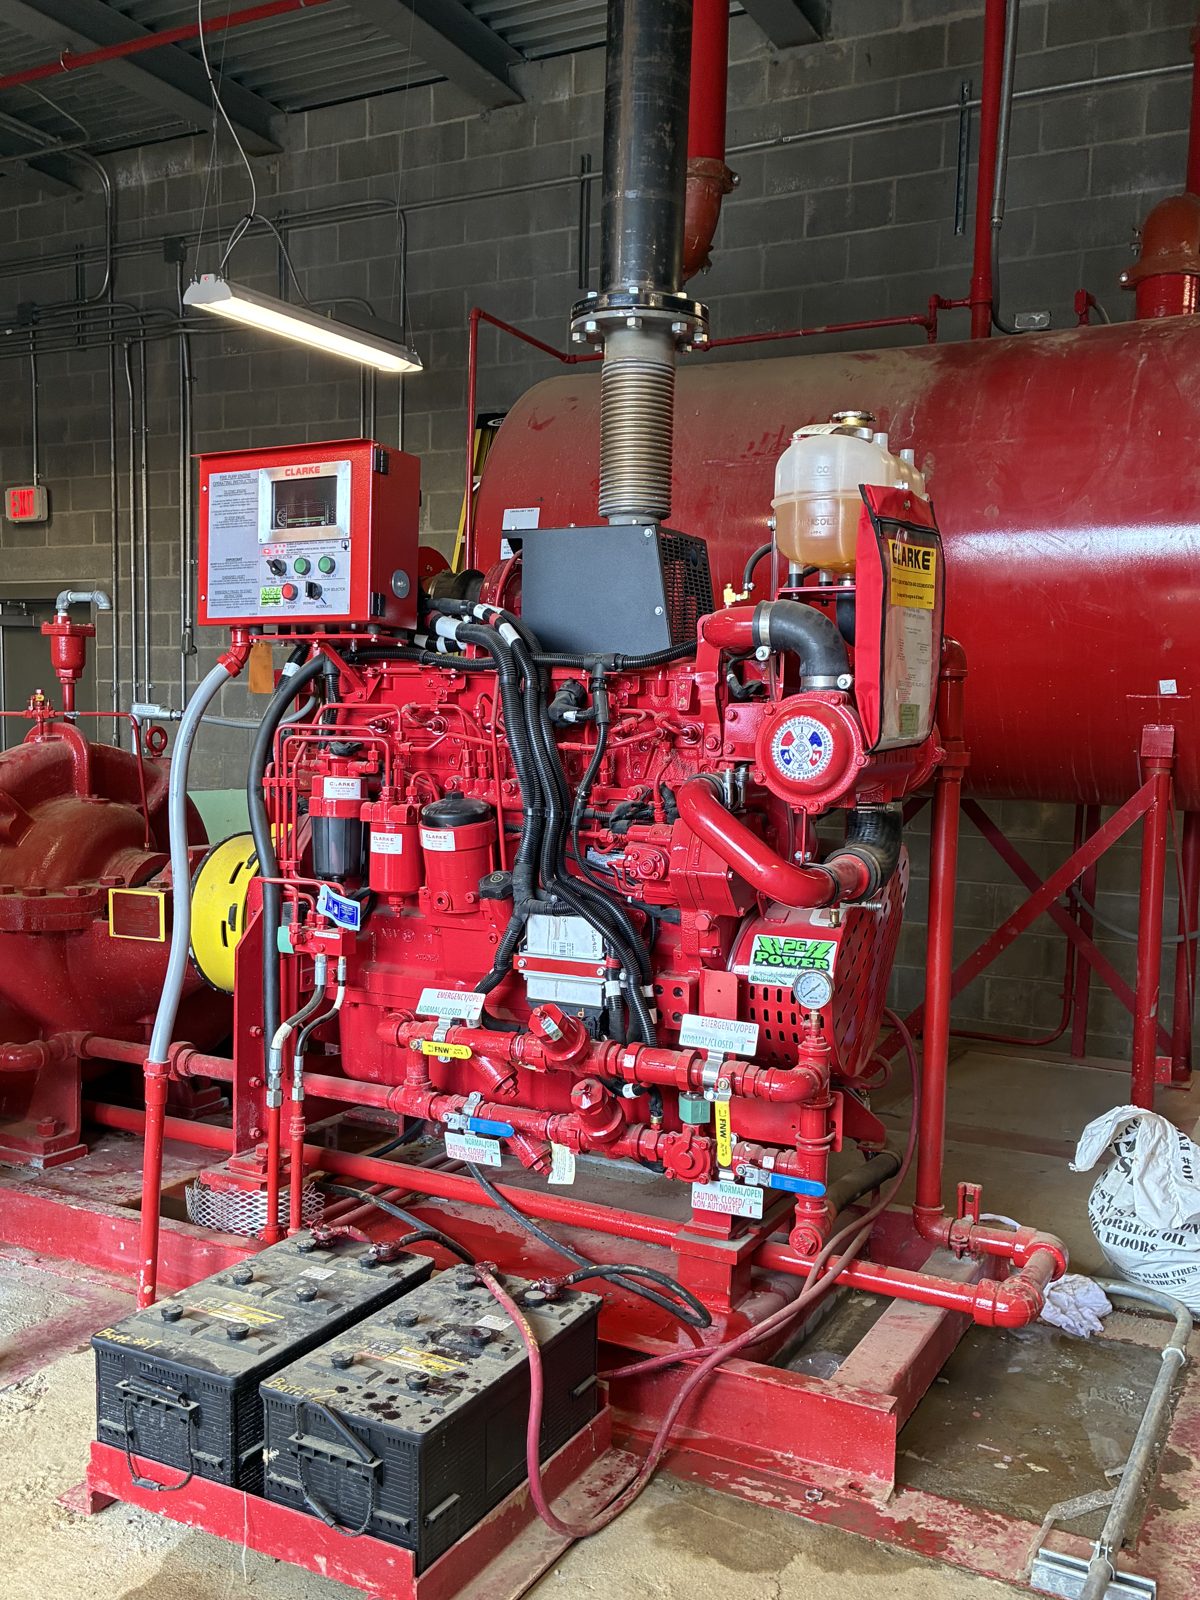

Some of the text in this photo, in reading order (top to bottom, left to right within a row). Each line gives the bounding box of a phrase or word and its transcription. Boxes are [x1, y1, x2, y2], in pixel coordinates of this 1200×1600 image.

[284, 465, 321, 477] CLARKE
[10, 490, 35, 518] EXIT
[892, 542, 931, 570] CLARKE
[783, 938, 807, 954] 2G
[753, 950, 830, 971] POWER
[701, 1018, 756, 1034] EMERGENCY/OPEN
[434, 1046, 450, 1054] FNW
[682, 1034, 734, 1050] NORMAL/CLOSED
[720, 1183, 762, 1198] NORMAL/OPEN
[692, 1200, 741, 1214] NON-AUTOMATIC
[1104, 1231, 1159, 1254] FLOORS
[1161, 1231, 1187, 1248] OIL
[1170, 1266, 1198, 1278] FIRES
